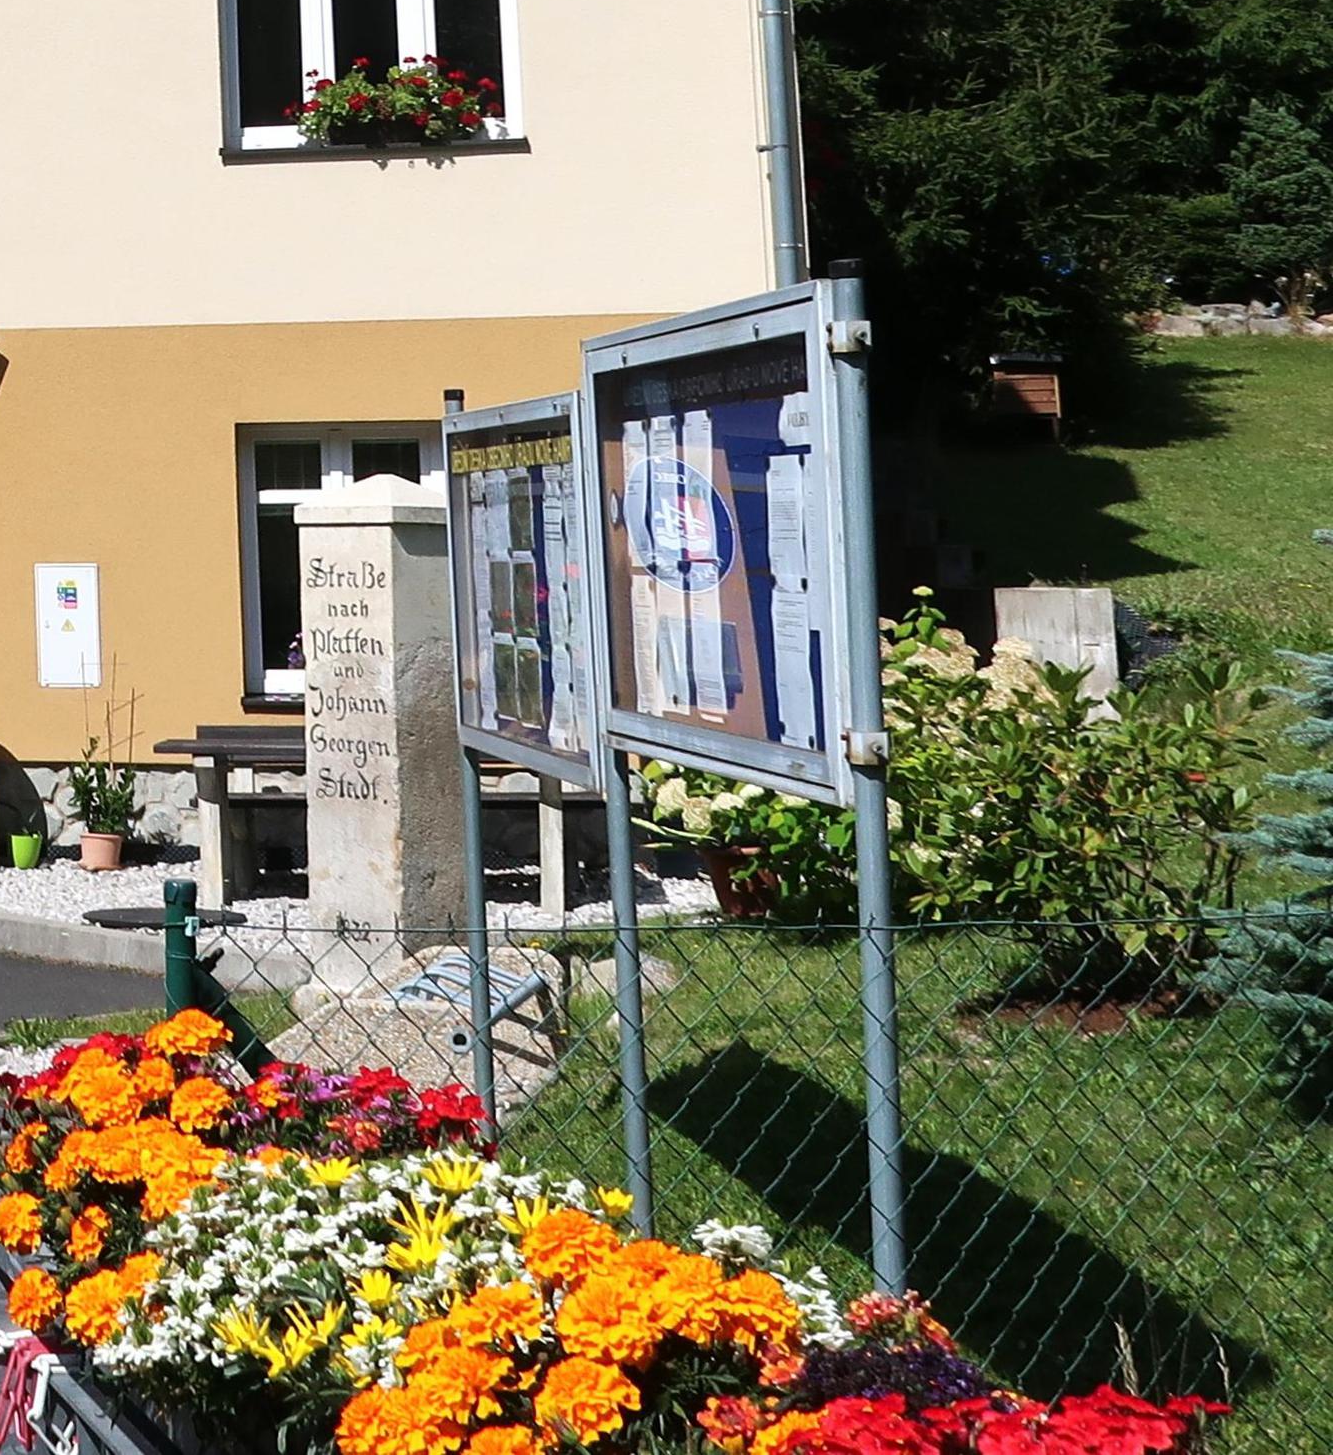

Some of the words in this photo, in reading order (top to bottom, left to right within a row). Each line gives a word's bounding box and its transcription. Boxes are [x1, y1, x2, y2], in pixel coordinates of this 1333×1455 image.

[306, 557, 386, 589] Straße
[327, 598, 369, 618] nach
[333, 662, 364, 679] und
[308, 684, 388, 721] Johann
[310, 723, 390, 769] Georgen
